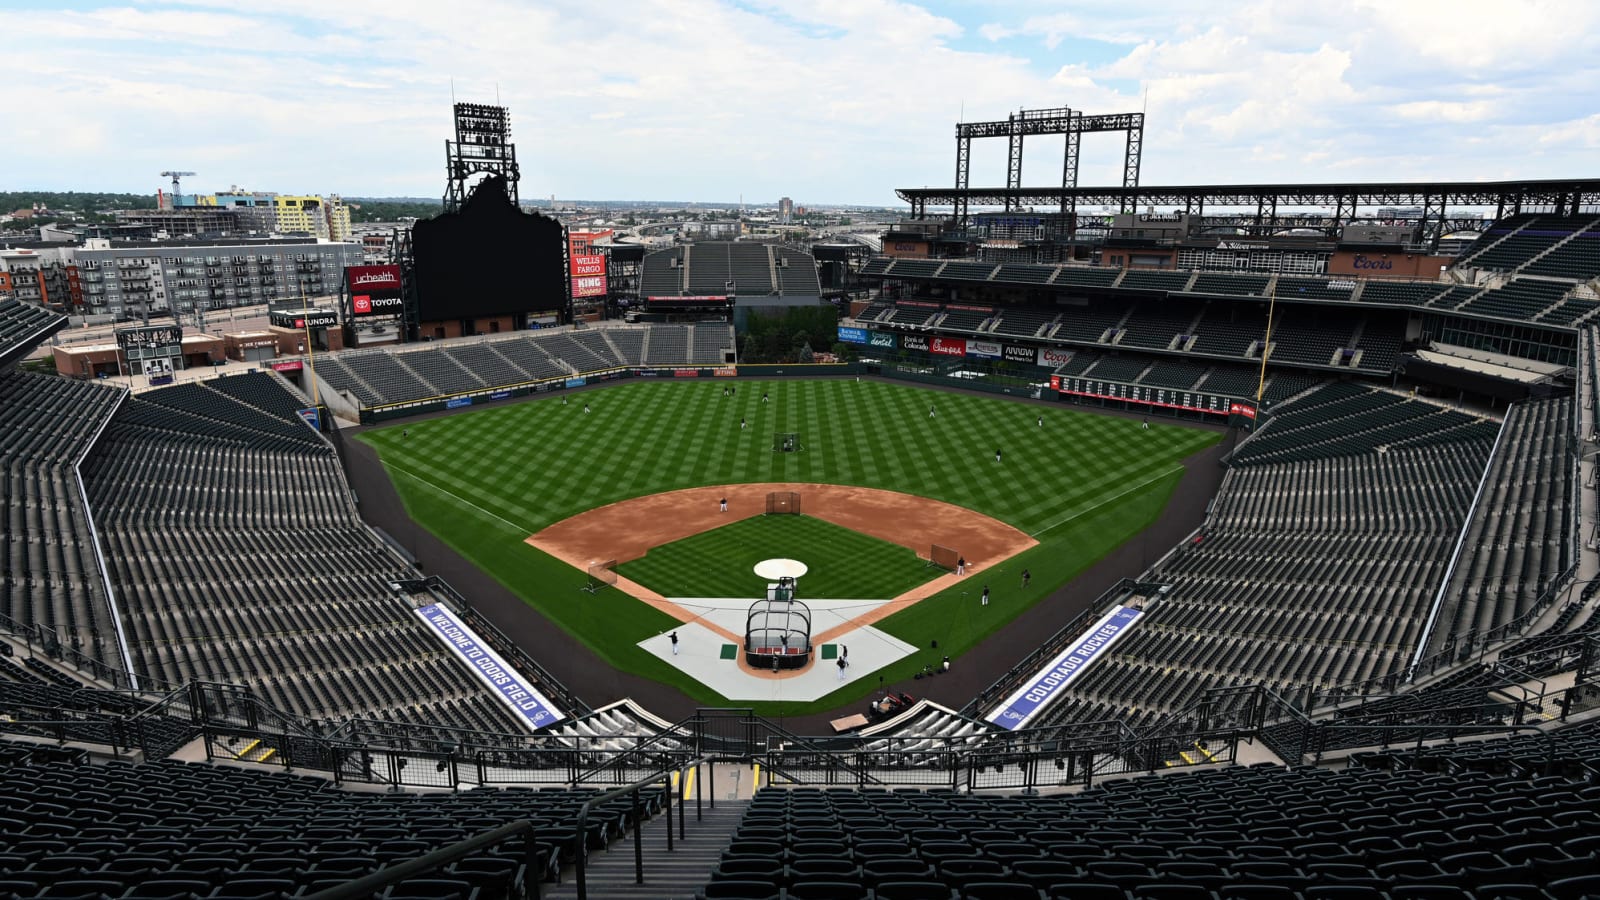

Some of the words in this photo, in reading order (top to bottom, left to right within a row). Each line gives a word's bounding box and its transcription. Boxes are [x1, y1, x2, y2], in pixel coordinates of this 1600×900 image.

[1353, 256, 1392, 269] Coors
[577, 265, 600, 273] FARGO
[356, 271, 395, 283] uchealth
[577, 278, 601, 288] KING
[371, 298, 402, 307] TOYOTA
[304, 317, 335, 327] TUNDRA
[871, 338, 892, 348] dental
[904, 335, 918, 343] Bank
[904, 342, 928, 351] Colorado
[1005, 346, 1034, 356] ARROW
[1044, 349, 1071, 363] Coor
[431, 614, 473, 648] WELCOME
[465, 646, 484, 659] TO
[476, 657, 511, 685] COORS
[503, 683, 537, 710] FIELD
[1025, 656, 1083, 703] COLORADO
[1076, 624, 1119, 657] ROCKIES
